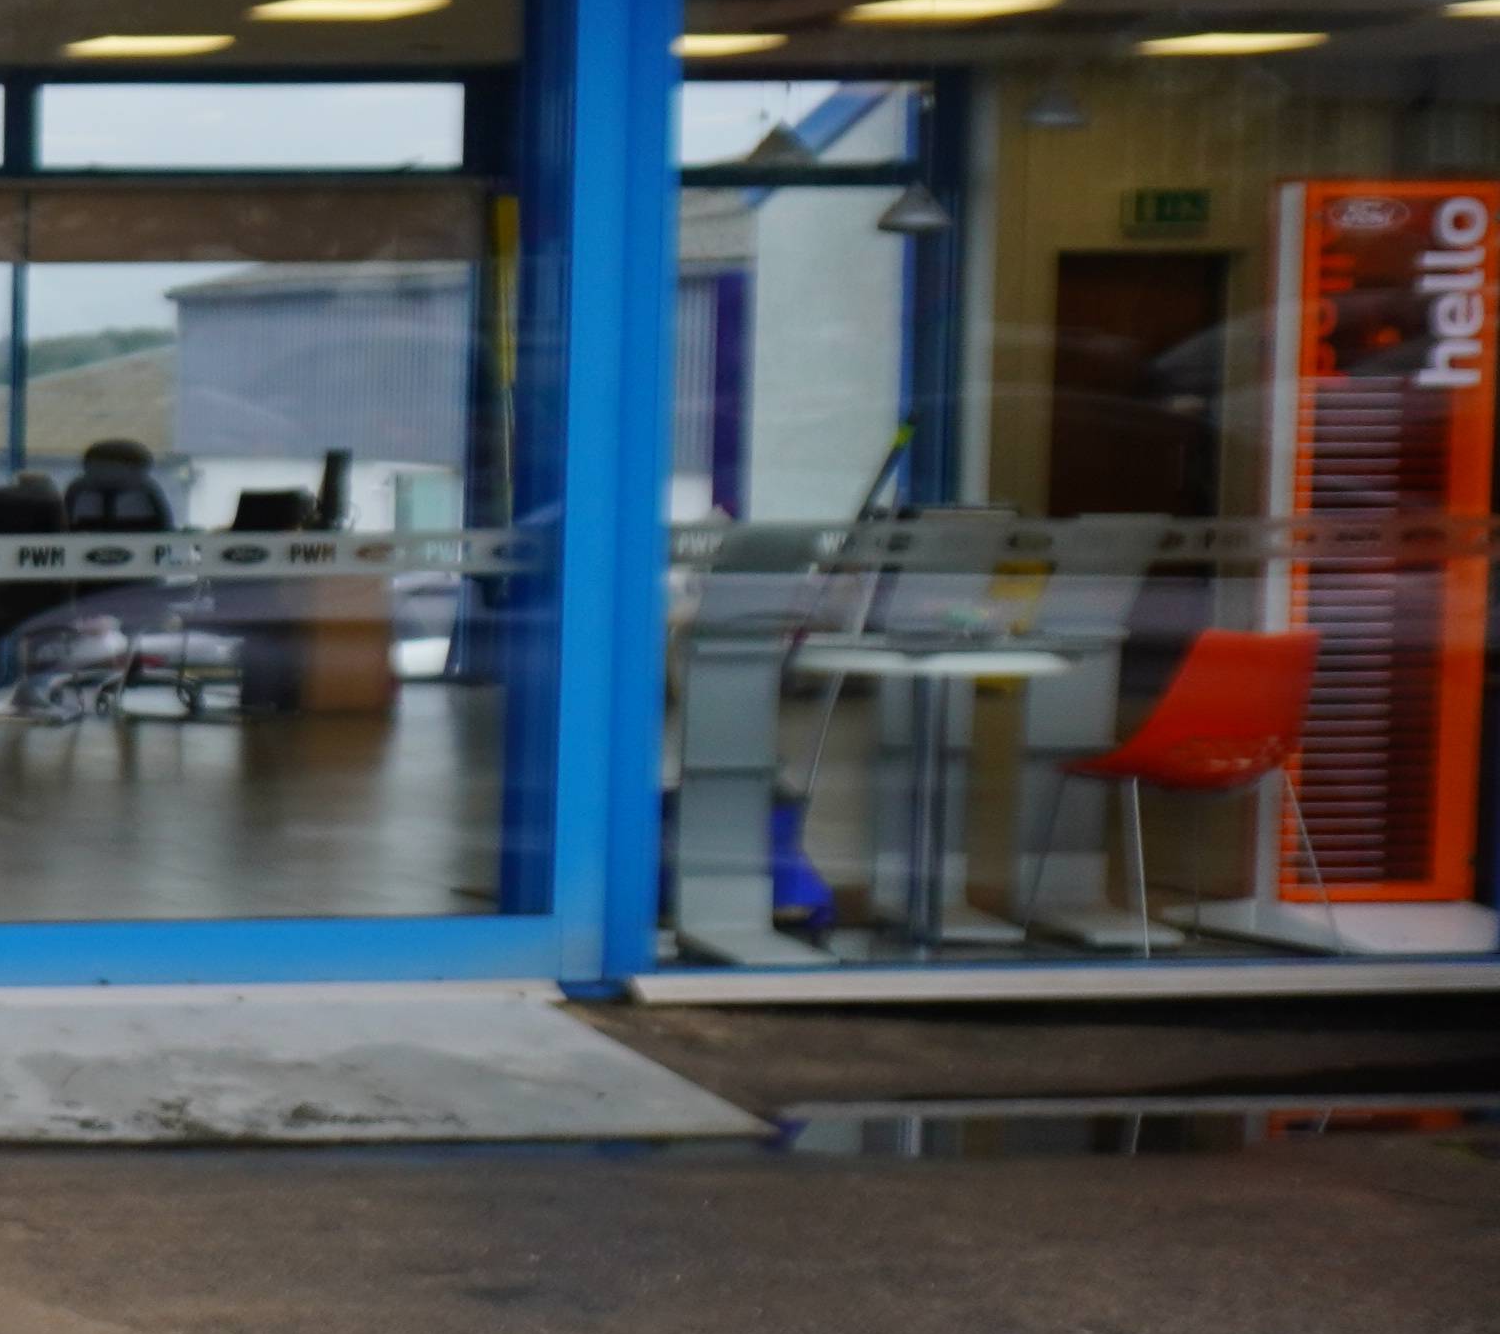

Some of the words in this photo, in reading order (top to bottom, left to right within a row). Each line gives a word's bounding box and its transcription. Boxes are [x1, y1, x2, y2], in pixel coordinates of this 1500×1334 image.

[1413, 196, 1489, 386] hello
[18, 545, 66, 567] PWM
[290, 541, 337, 564] PWM
